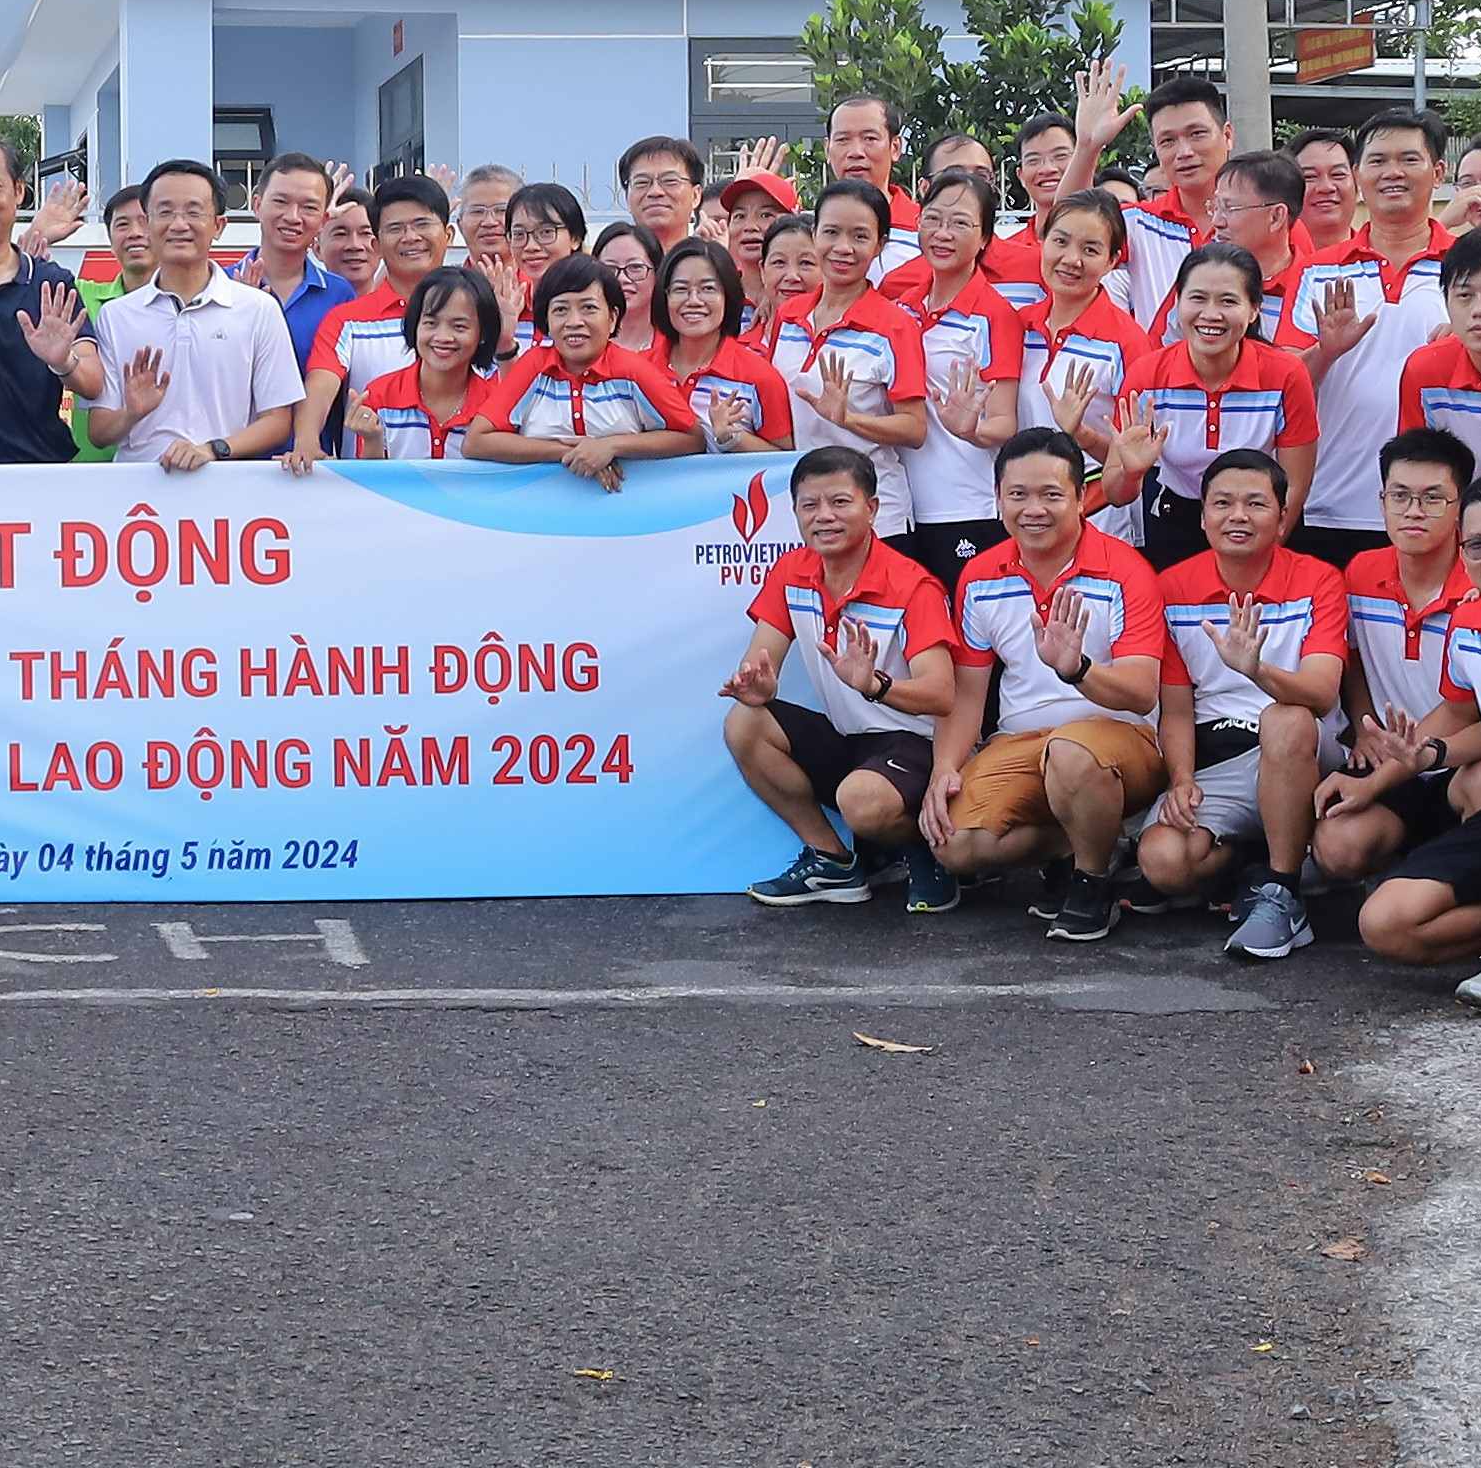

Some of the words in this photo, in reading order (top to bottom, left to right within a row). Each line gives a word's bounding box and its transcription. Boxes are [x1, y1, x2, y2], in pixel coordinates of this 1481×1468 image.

[55, 503, 291, 602] ĐỘNG
[721, 566, 744, 586] PV
[10, 637, 218, 700] THÁNG
[241, 635, 410, 696] HÀNH
[431, 632, 599, 704] ĐỘNG
[10, 741, 123, 791] LAO
[144, 727, 311, 800] ĐỘNG
[334, 726, 470, 786] NĂM
[493, 734, 633, 785] 2024
[38, 843, 74, 872] 04
[85, 840, 170, 879] tháng
[180, 841, 199, 870] 5
[207, 839, 272, 870] năm
[281, 839, 359, 869] 2024
